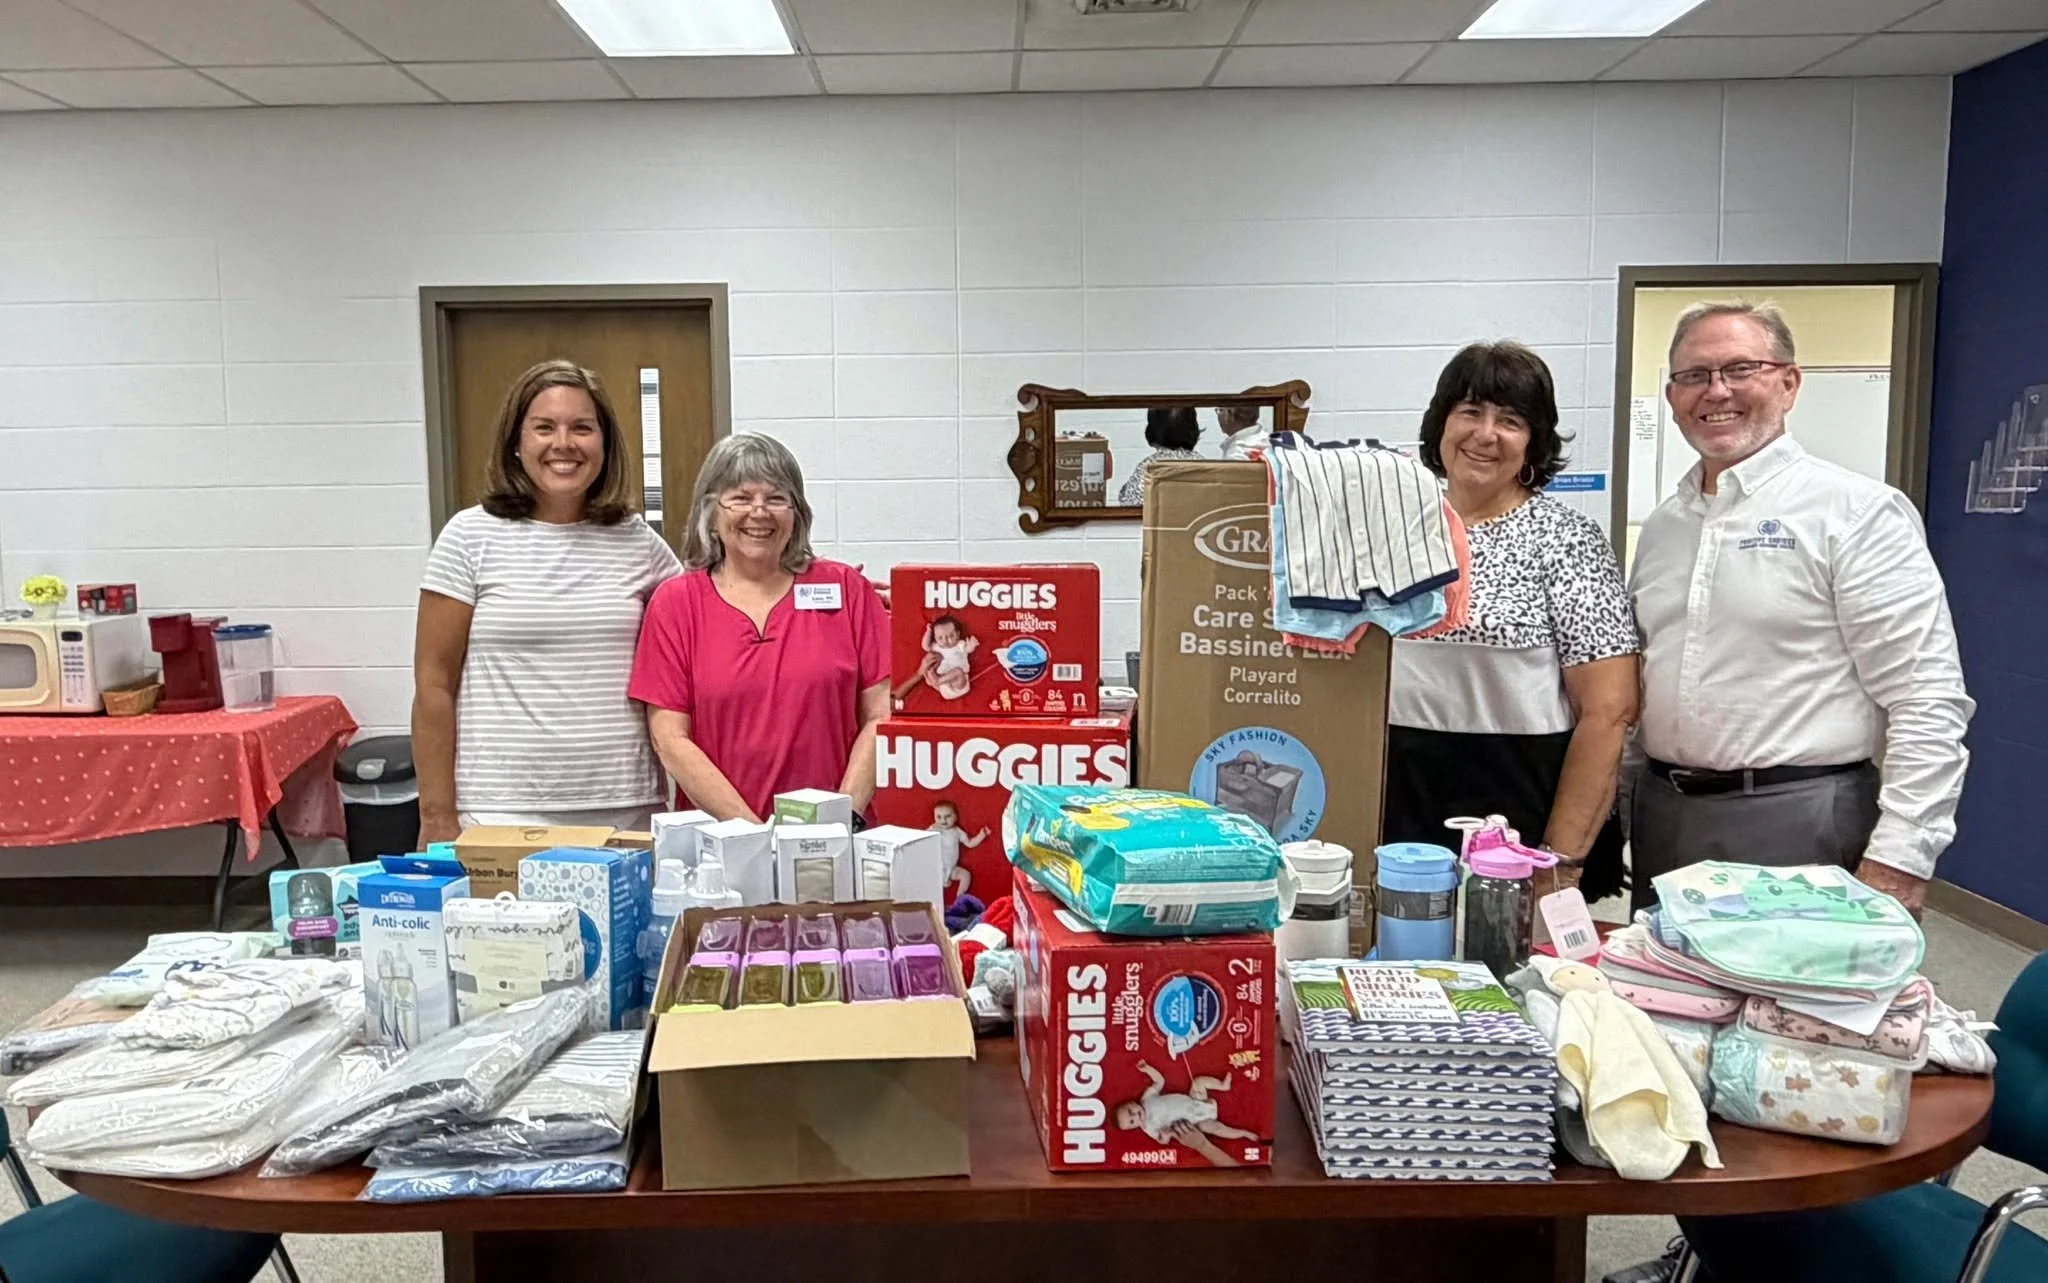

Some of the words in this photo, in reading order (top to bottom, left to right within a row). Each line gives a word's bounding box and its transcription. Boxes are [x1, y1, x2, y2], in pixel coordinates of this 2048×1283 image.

[925, 580, 1057, 609] HUGGIES
[1215, 584, 1258, 601] Pack
[998, 616, 1057, 633] snugglers
[1193, 604, 1254, 629] Care
[1230, 666, 1297, 686] Playard
[1047, 689, 1063, 700] 84
[1224, 688, 1302, 706] Corralito
[1205, 741, 1226, 762] SKY
[1228, 730, 1288, 747] FASHION
[876, 735, 1128, 793] HUGGIES
[1299, 809, 1316, 833] SKY
[372, 914, 431, 930] Anti-colic
[1228, 958, 1254, 976] 2
[1236, 982, 1248, 1001] 84
[1356, 991, 1442, 999] STORIES
[1112, 995, 1127, 1026] little
[1125, 962, 1143, 1052] snugglers
[1063, 963, 1107, 1164] HUGGIES
